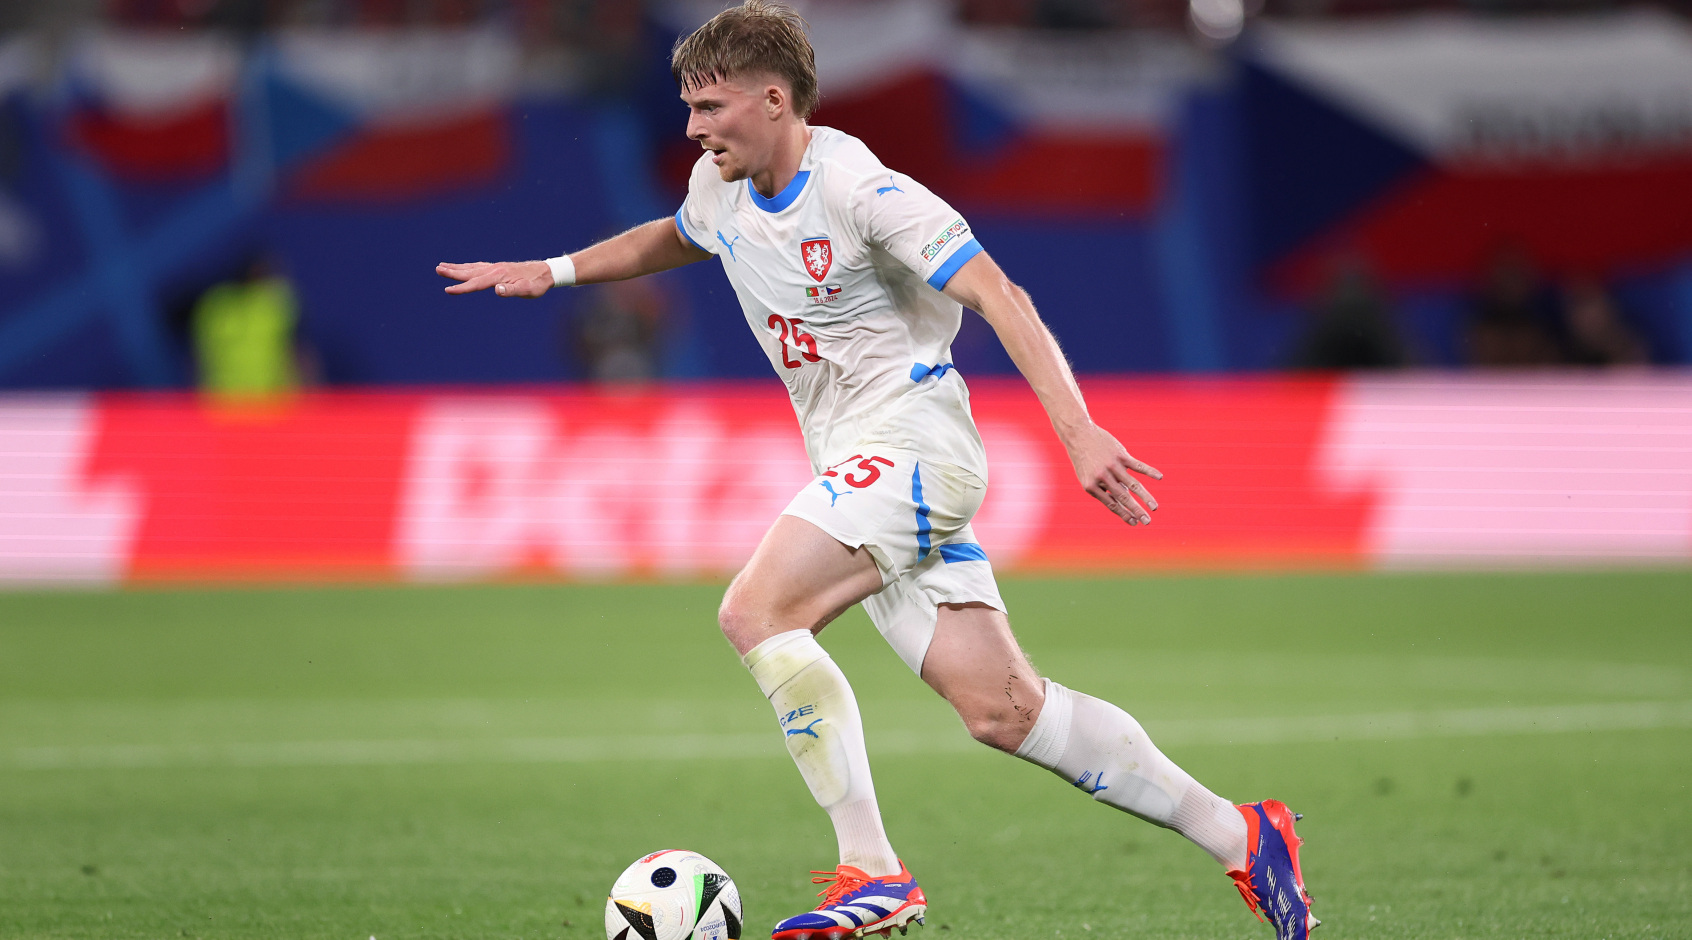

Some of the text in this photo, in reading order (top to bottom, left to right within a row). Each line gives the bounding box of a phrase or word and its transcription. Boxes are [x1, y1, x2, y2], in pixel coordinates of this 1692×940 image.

[923, 221, 965, 261] FOUNDATION
[768, 314, 822, 369] 25
[780, 704, 814, 727] CZE
